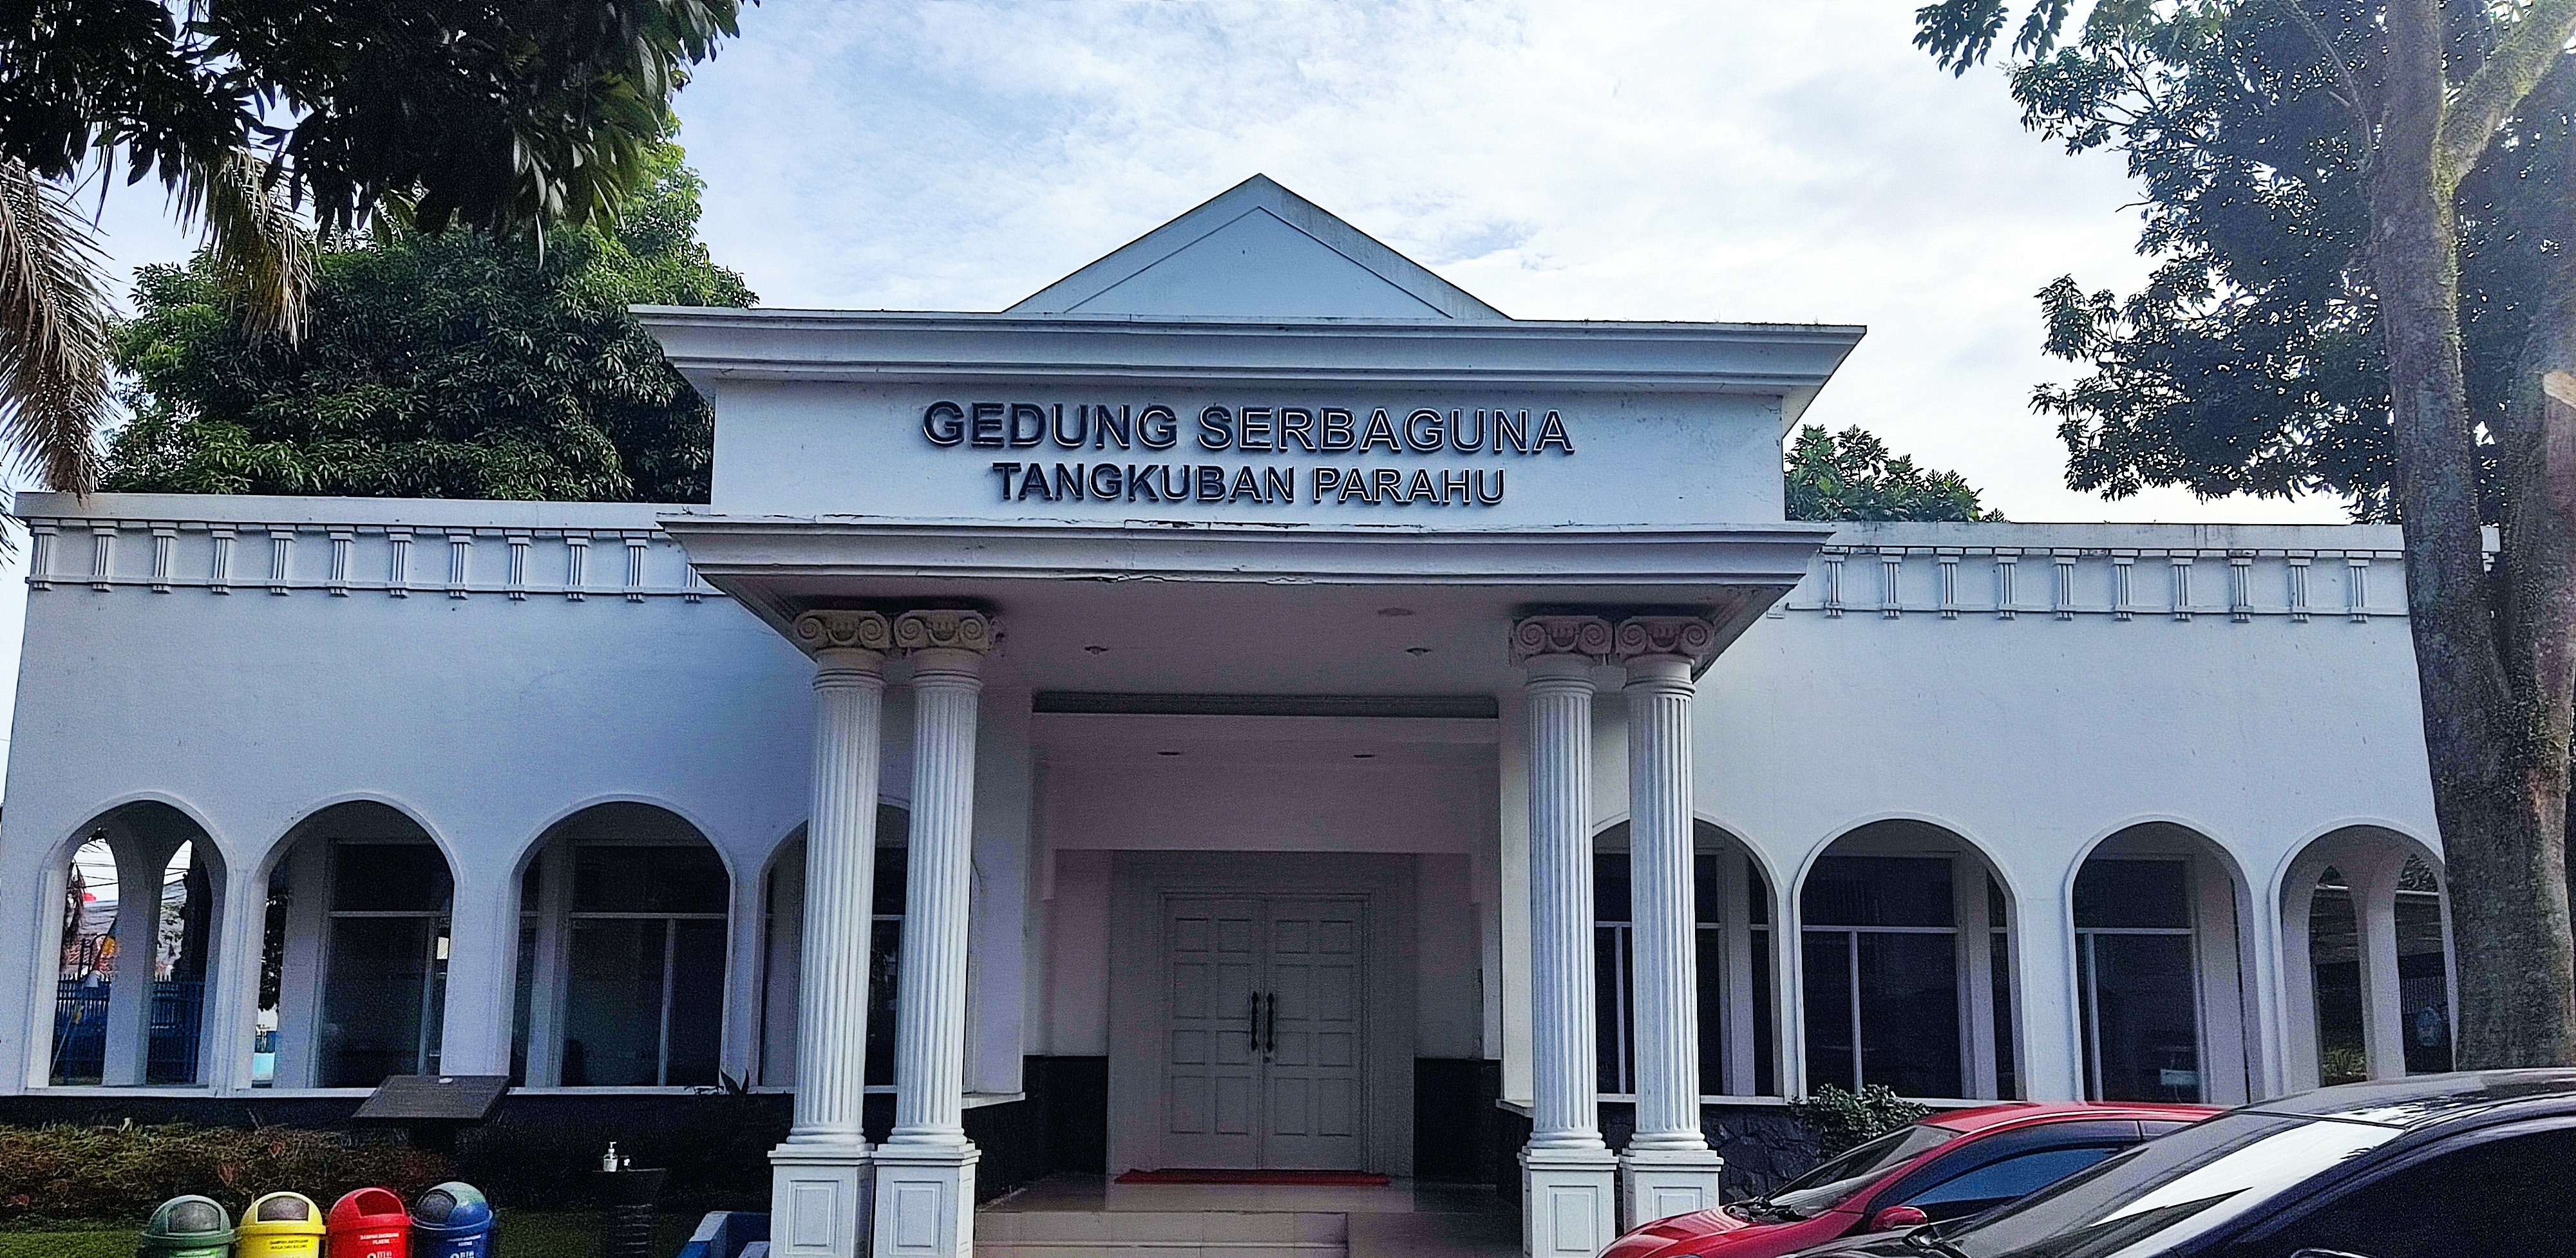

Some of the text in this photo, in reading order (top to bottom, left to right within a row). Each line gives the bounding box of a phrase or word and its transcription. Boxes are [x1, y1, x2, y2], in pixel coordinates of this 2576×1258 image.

[923, 401, 1575, 454] GEDUNG SERBAGUNA
[992, 462, 1505, 505] TANGKUBAN PARAHU
